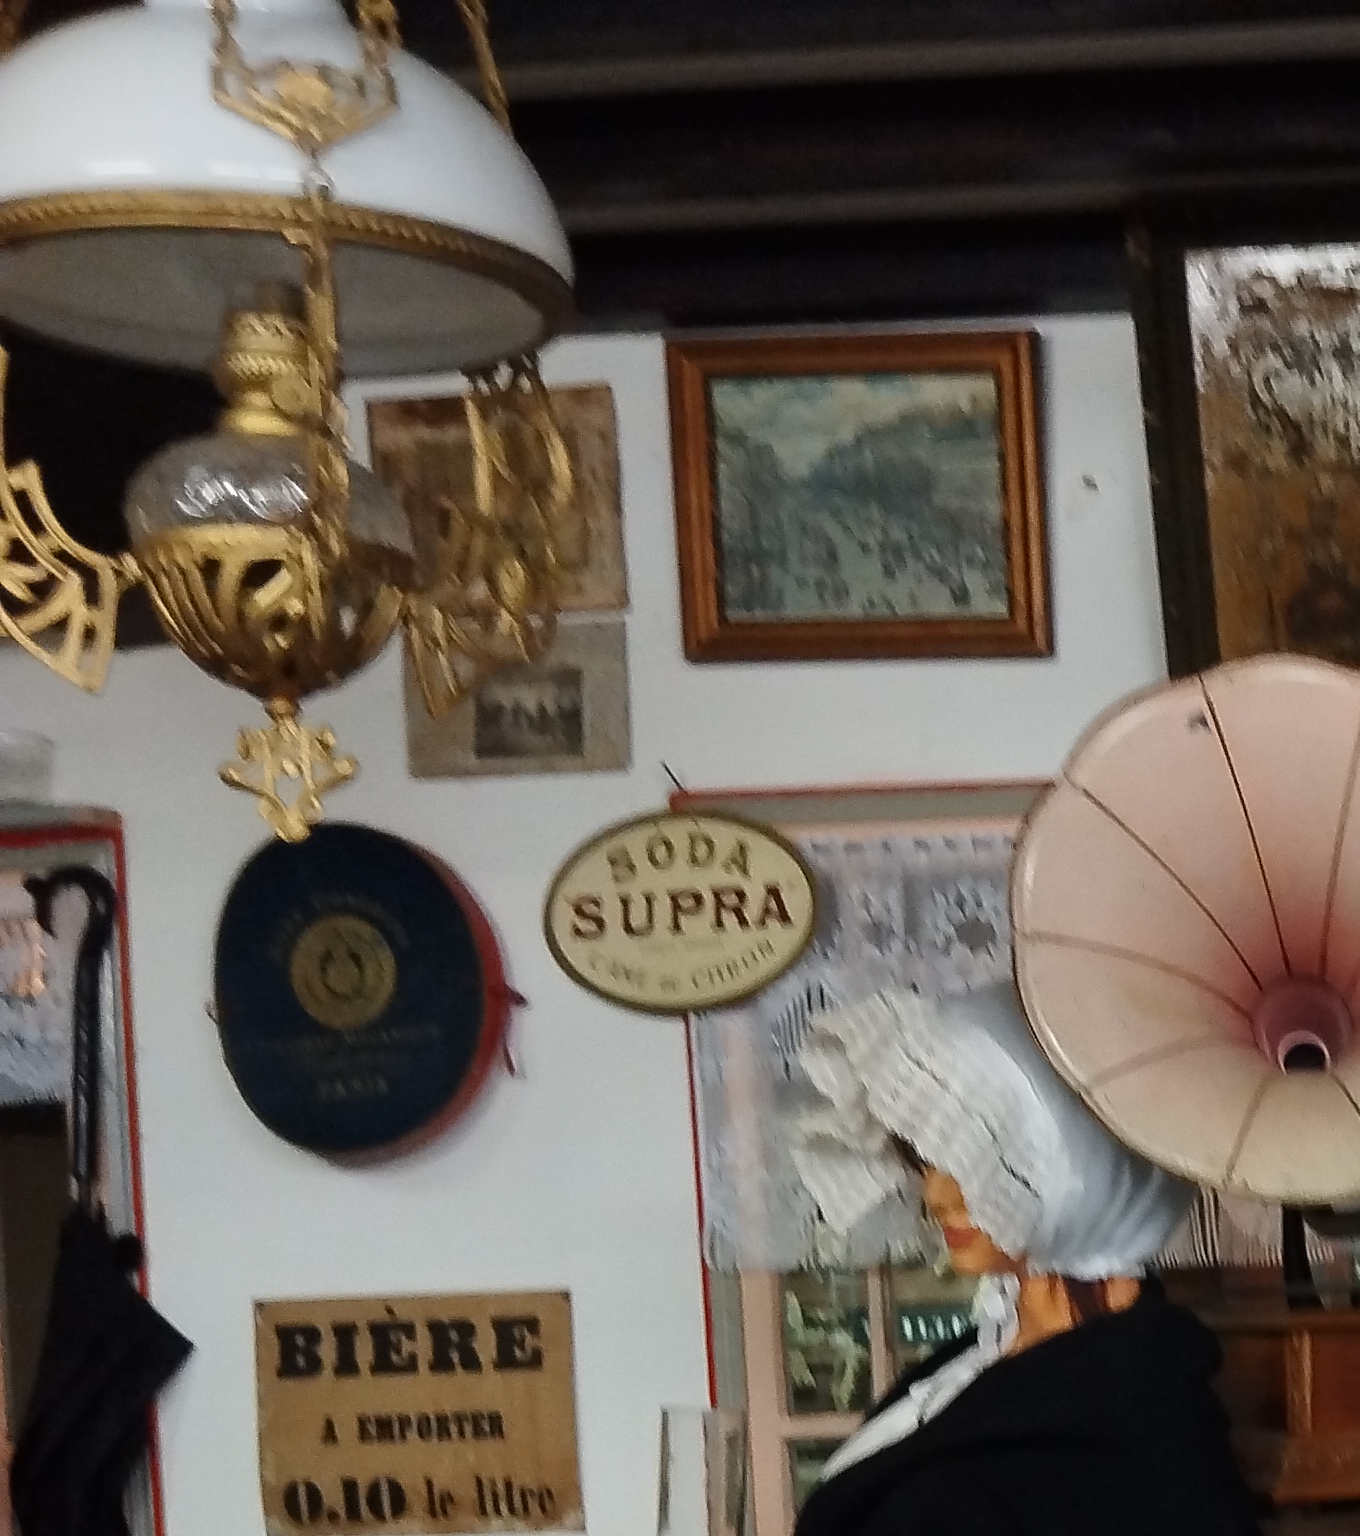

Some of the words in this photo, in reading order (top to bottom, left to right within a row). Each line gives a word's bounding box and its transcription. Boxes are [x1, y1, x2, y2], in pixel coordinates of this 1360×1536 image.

[607, 820, 753, 884] SODA
[571, 883, 795, 941] SUPRA
[275, 1304, 544, 1379] BIÈRE
[321, 1413, 339, 1446] A
[356, 1409, 506, 1444] EMPORTER
[282, 1475, 409, 1525] 0.10
[424, 1475, 455, 1520] le
[474, 1475, 557, 1520] litre
